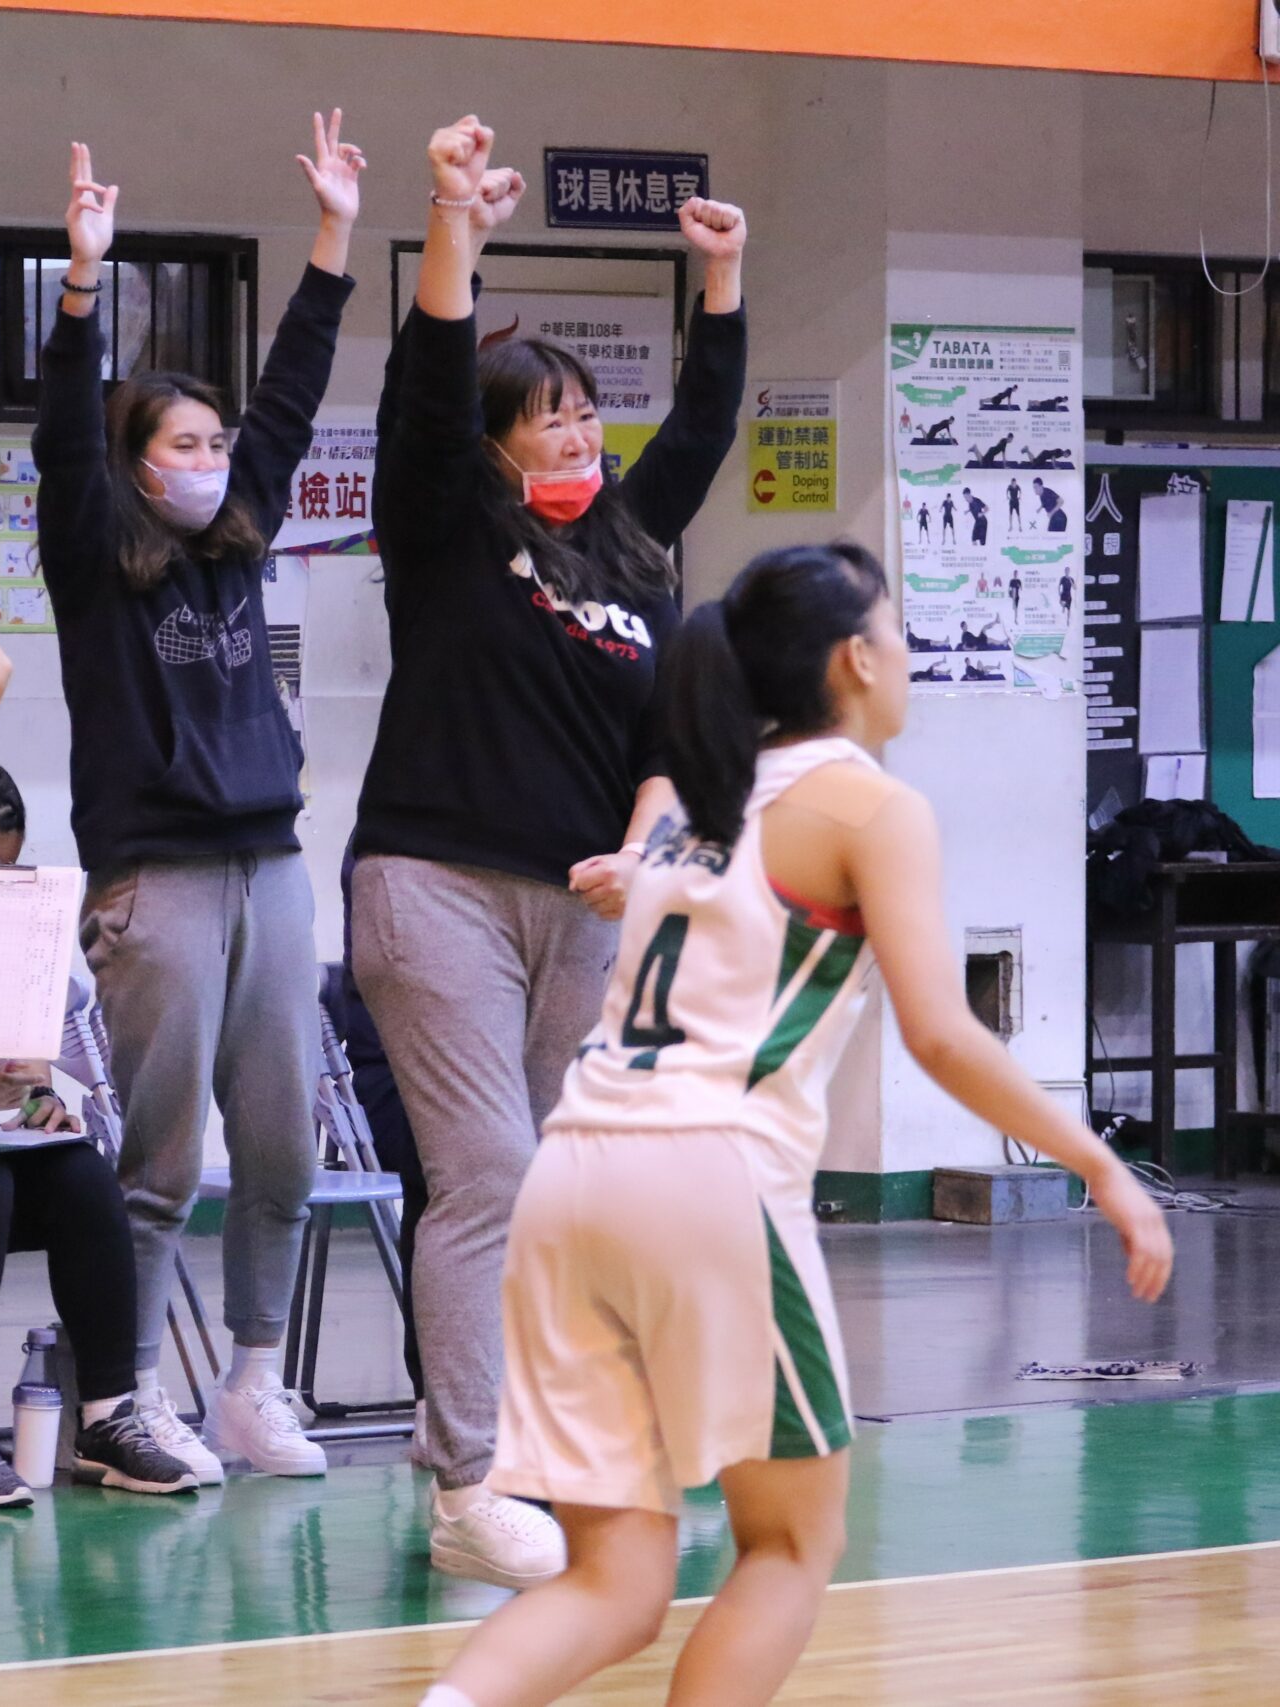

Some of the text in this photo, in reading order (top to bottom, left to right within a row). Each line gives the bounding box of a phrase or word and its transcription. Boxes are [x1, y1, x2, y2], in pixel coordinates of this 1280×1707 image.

[540, 321, 623, 337] 中華民國108年
[567, 343, 650, 360] 等學校運動會
[933, 341, 991, 355] TABATA
[758, 427, 829, 447] 運動禁藥
[776, 451, 829, 470] 管制站
[792, 475, 829, 489] Doping
[285, 471, 366, 520] 檢站
[792, 491, 829, 503] Control
[622, 912, 690, 1048] 4
